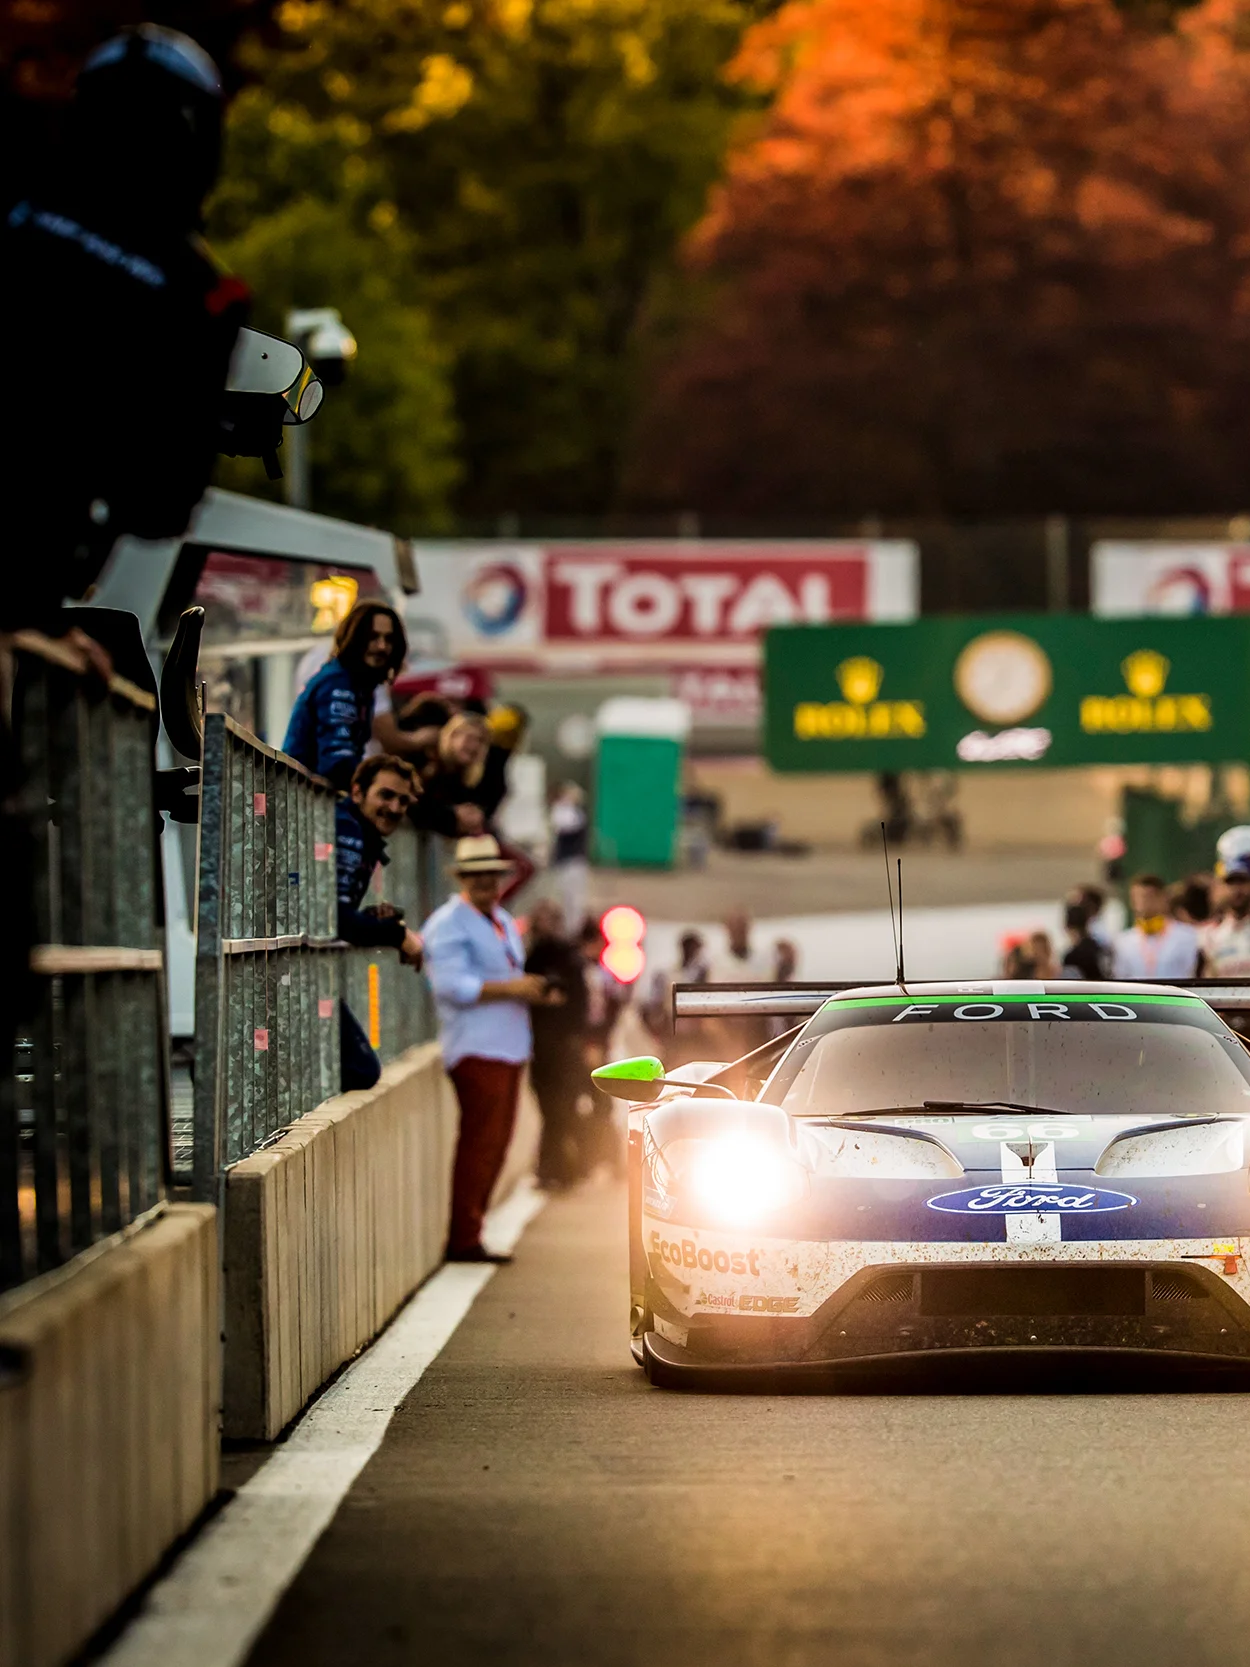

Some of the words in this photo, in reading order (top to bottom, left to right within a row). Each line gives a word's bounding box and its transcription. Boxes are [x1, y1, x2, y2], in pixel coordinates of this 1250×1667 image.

[553, 561, 832, 636] TOTAL
[892, 1003, 1138, 1022] FORD
[971, 1122, 1080, 1140] 66
[968, 1186, 1096, 1209] Ford
[650, 1230, 761, 1277] EcoBoost
[707, 1293, 736, 1307] Castrol
[739, 1295, 801, 1312] EDGE
